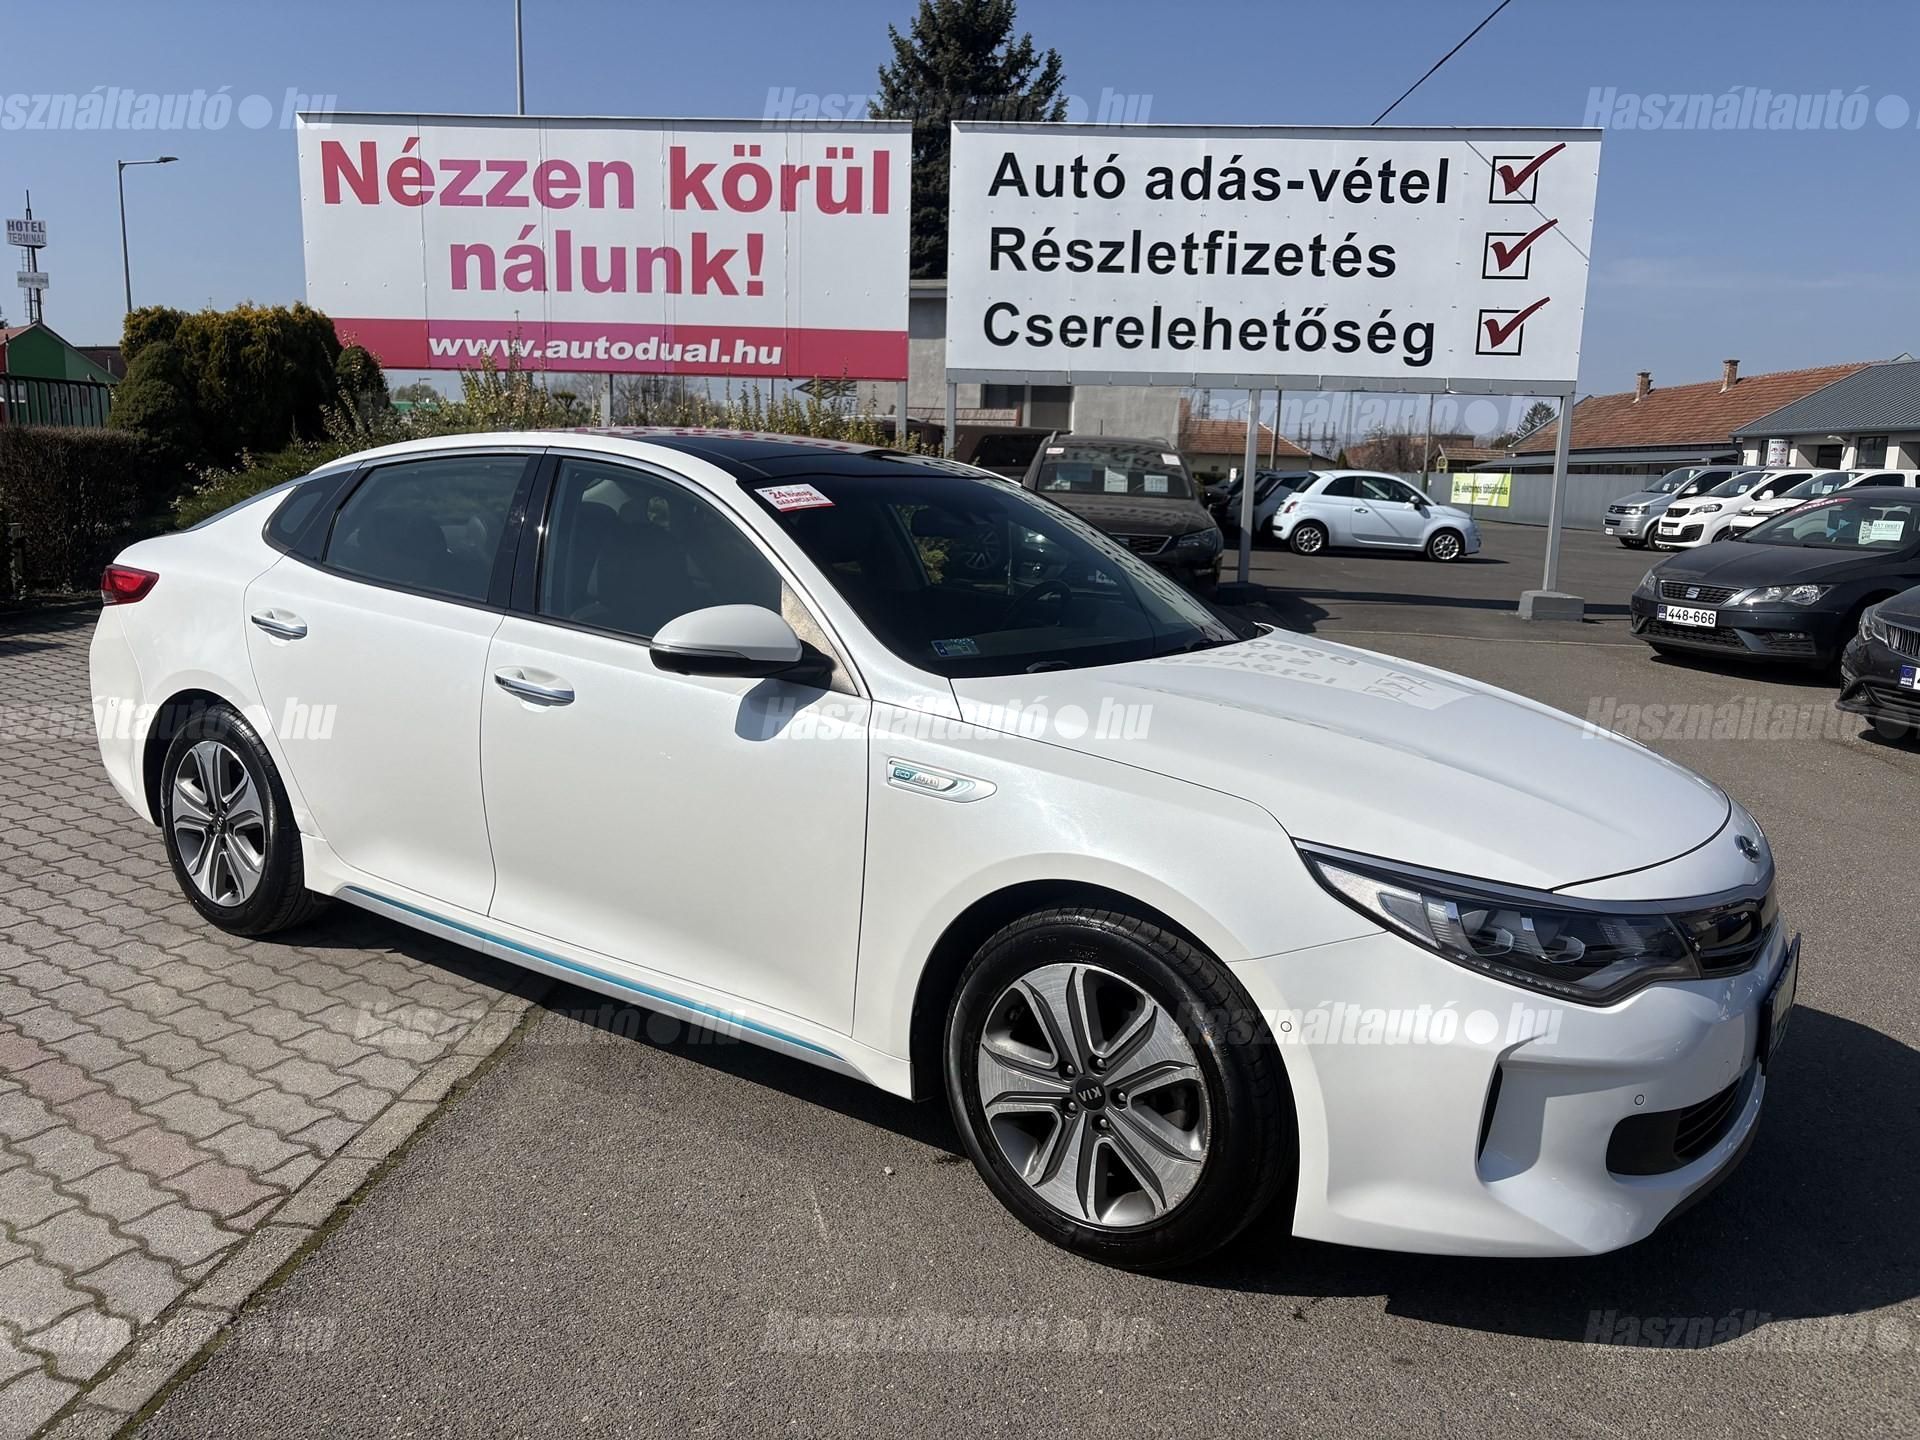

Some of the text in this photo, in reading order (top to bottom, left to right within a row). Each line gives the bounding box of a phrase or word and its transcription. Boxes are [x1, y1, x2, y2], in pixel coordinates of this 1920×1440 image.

[322, 137, 890, 215] Nézzen körül
[988, 153, 1449, 204] Autó adás-vétel
[7, 220, 45, 232] HOTEL
[8, 232, 46, 244] TERMINAL
[450, 225, 764, 297] nálunk!
[990, 226, 1396, 278] Részletfizetés
[983, 301, 1435, 367] Cserelehetőség
[429, 336, 782, 365] www.autodual.hu
[769, 491, 786, 499] 24
[1668, 608, 1715, 625] 448-666
[895, 769, 911, 779] ECO
[1078, 1086, 1102, 1101] KIA
